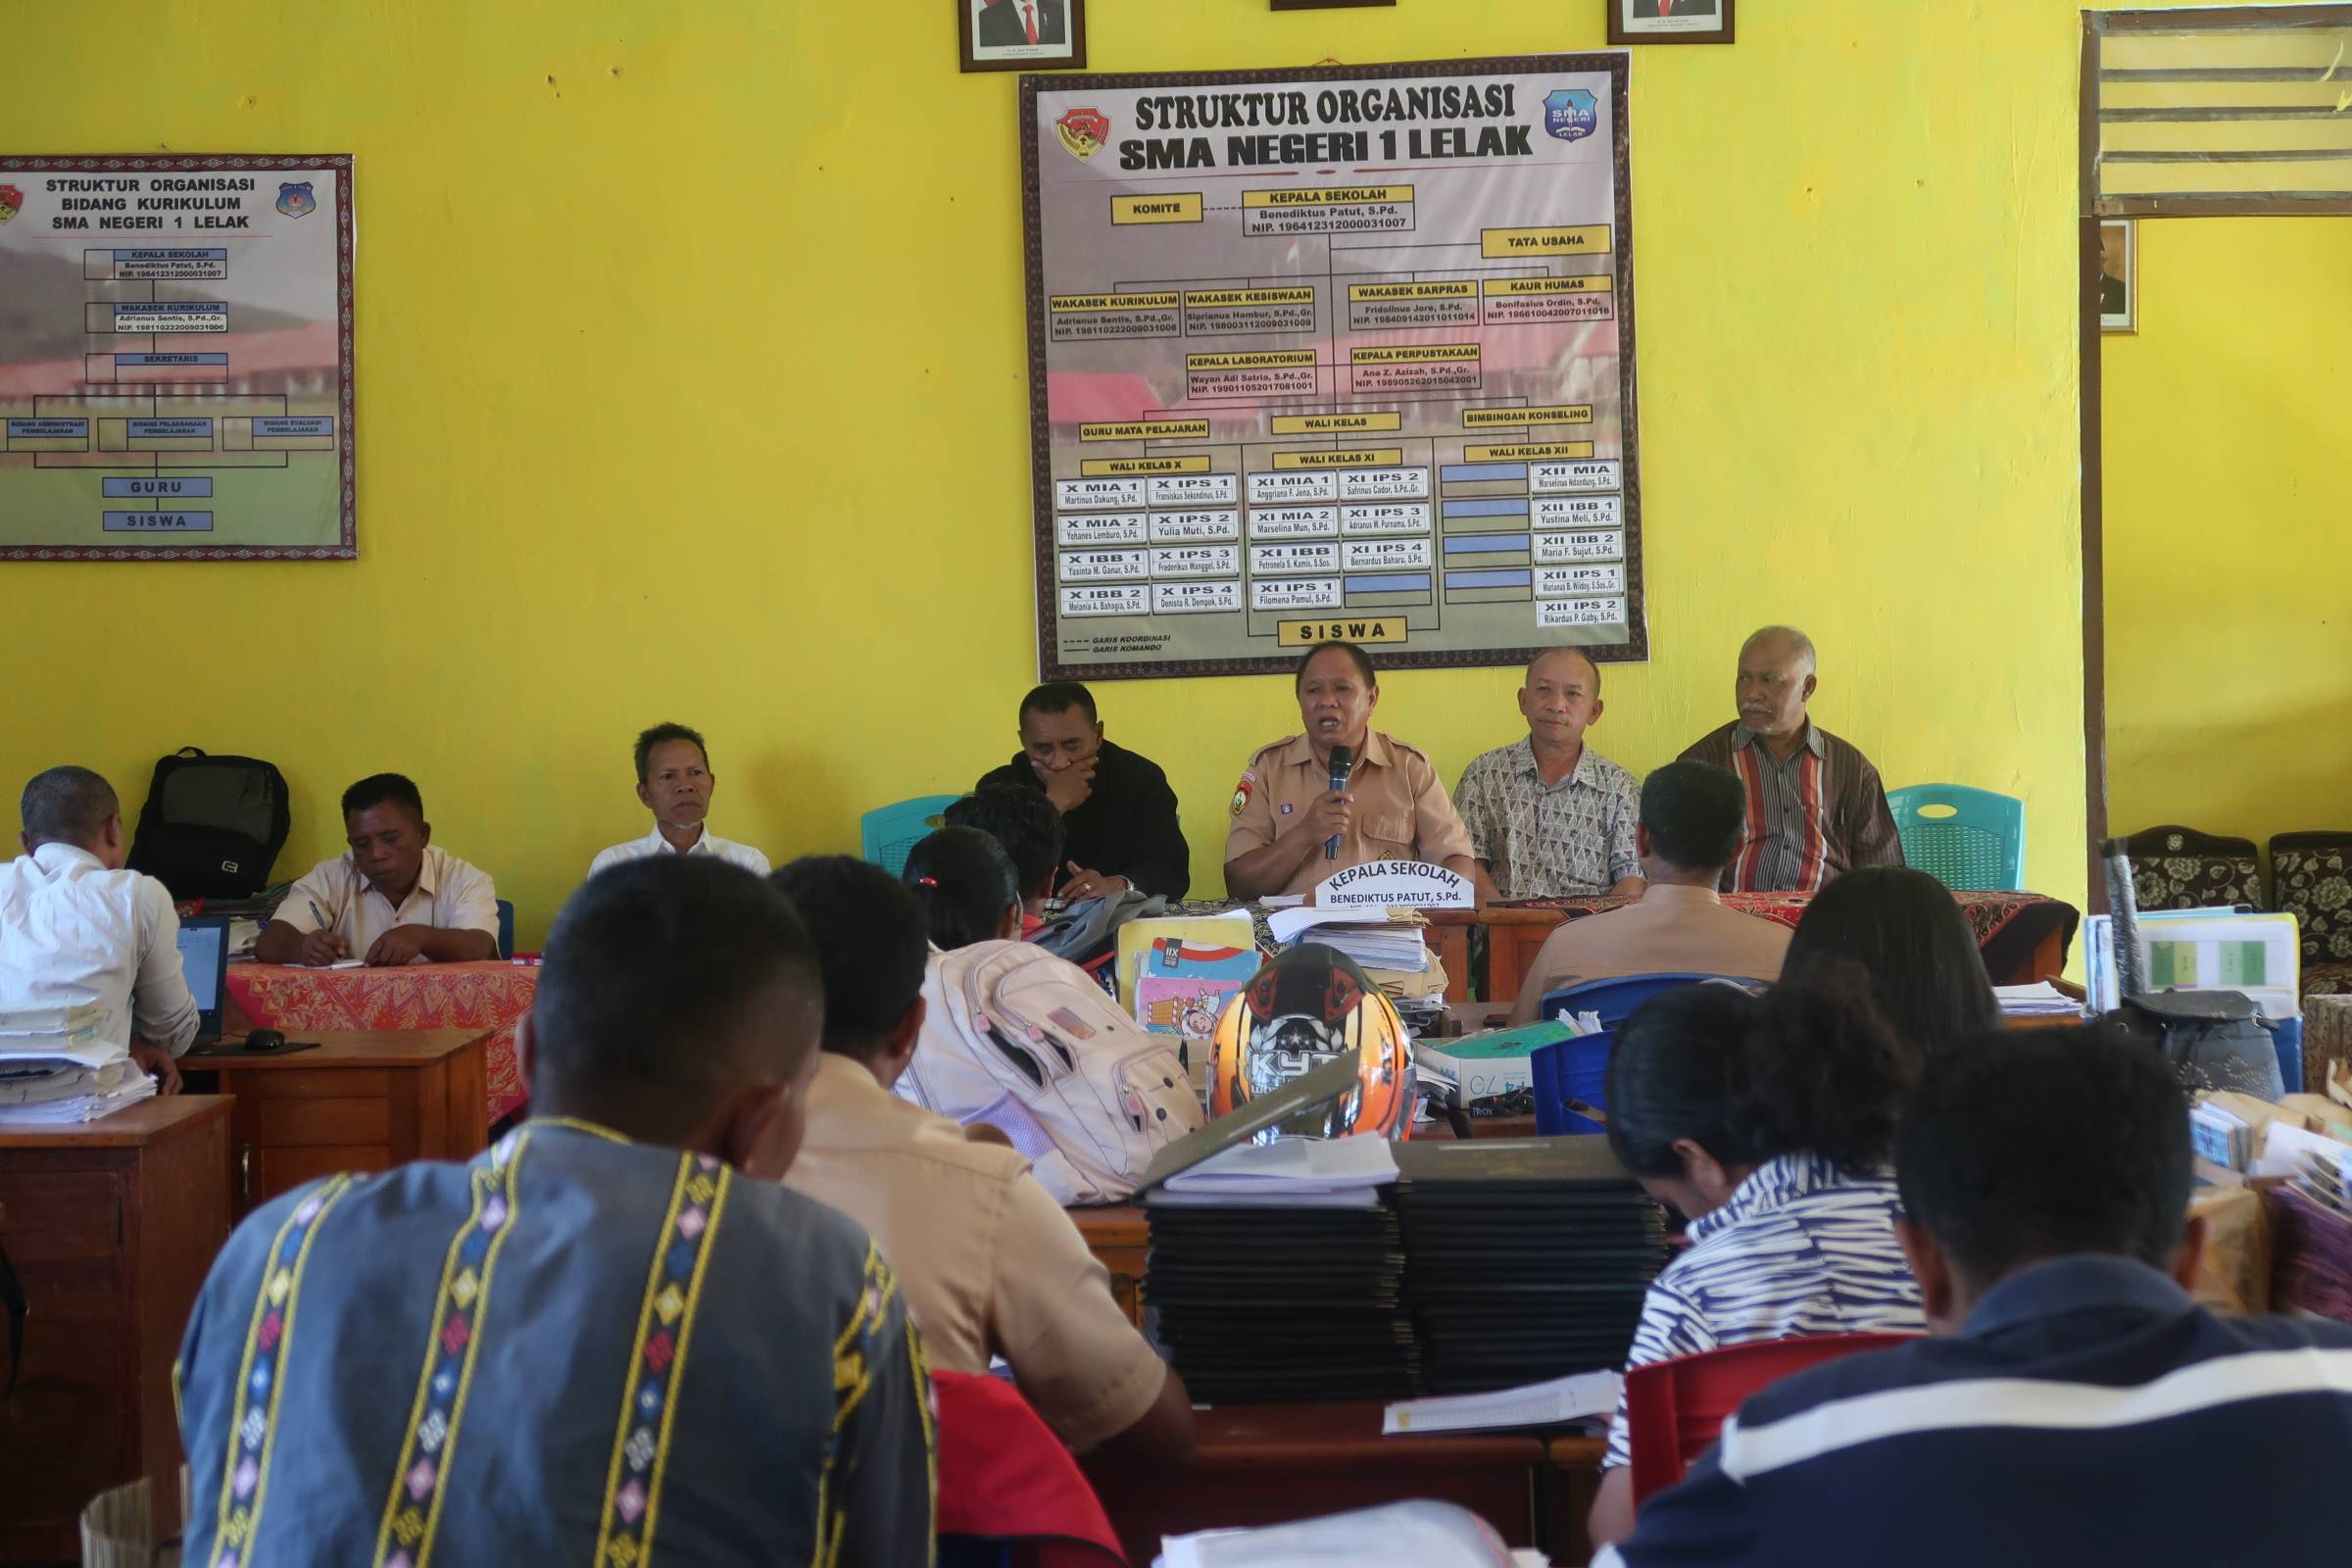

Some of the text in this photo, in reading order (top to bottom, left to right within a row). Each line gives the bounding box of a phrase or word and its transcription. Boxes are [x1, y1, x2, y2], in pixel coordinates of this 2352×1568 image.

[1135, 83, 1516, 129] STRUKTUR ORGANISASI
[1552, 109, 1590, 118] SMA
[1119, 124, 1534, 171] SMA NEGERI 1 LELAK
[46, 178, 256, 192] STRUKTUR ORGANISASI
[1269, 188, 1387, 204] KEPALA SEKOLAH
[62, 198, 241, 211] BIDANG KURIKULUM
[1133, 203, 1181, 215] KOMITE
[1259, 205, 1398, 220] Benediktus Patut, S.Pd.
[52, 216, 249, 229] SMA NEGERI 1 LELAK
[1252, 222, 1274, 232] NIP.
[1508, 235, 1584, 247] TATA USAHA
[1358, 284, 1468, 298] WAKASEK SARPRAS
[1510, 279, 1585, 292] KAUR HUMAS
[1053, 295, 1177, 309] WAKASEK KURIKULUM
[1188, 290, 1311, 304] WAKASEK KESISWAAN
[1353, 347, 1477, 361] KEPALA PERPUSTAKAAN
[1189, 354, 1313, 368] KEPALA LABORATORIUM
[1191, 375, 1220, 385] Wayan
[1223, 373, 1239, 382] Adi
[1241, 372, 1271, 383] Satria,
[1192, 385, 1208, 394] NIP.
[1466, 409, 1589, 422] BIMBINGAN KONSELING
[1304, 417, 1367, 428] WALI KELAS
[1083, 423, 1206, 436] GURU MATA PELAJARAN
[1490, 446, 1568, 457] WALI KELAS XII
[1299, 455, 1325, 465] WALI
[1328, 454, 1361, 464] KELAS
[1110, 462, 1135, 471] WALI
[1139, 461, 1172, 470] KELAS
[1574, 466, 1610, 474] MIA
[131, 482, 181, 493] GURU
[1086, 483, 1121, 492] MIA
[127, 516, 186, 527] SISWA
[1282, 512, 1313, 520] MIA
[1541, 514, 1569, 523] Yustina
[1593, 513, 1612, 522] S.Pd.
[1158, 525, 1230, 536] Yulia Muti, S.Pd.
[1257, 523, 1330, 534] Marselina Mun, S.Pd.
[1543, 536, 1564, 545] XII
[1292, 547, 1330, 556] IBB
[1377, 544, 1405, 553] IPS
[1574, 569, 1600, 578] IPS
[1090, 590, 1123, 599] IBB
[1182, 586, 1214, 595] IPS
[1545, 603, 1567, 612] XII
[1300, 622, 1385, 640] SISWA
[1120, 634, 1171, 643] KOORDINASI
[1329, 862, 1460, 891] KEPALA SEKOLAH
[1331, 892, 1461, 904] BENEDIKTUS PATUT, S.Pd.
